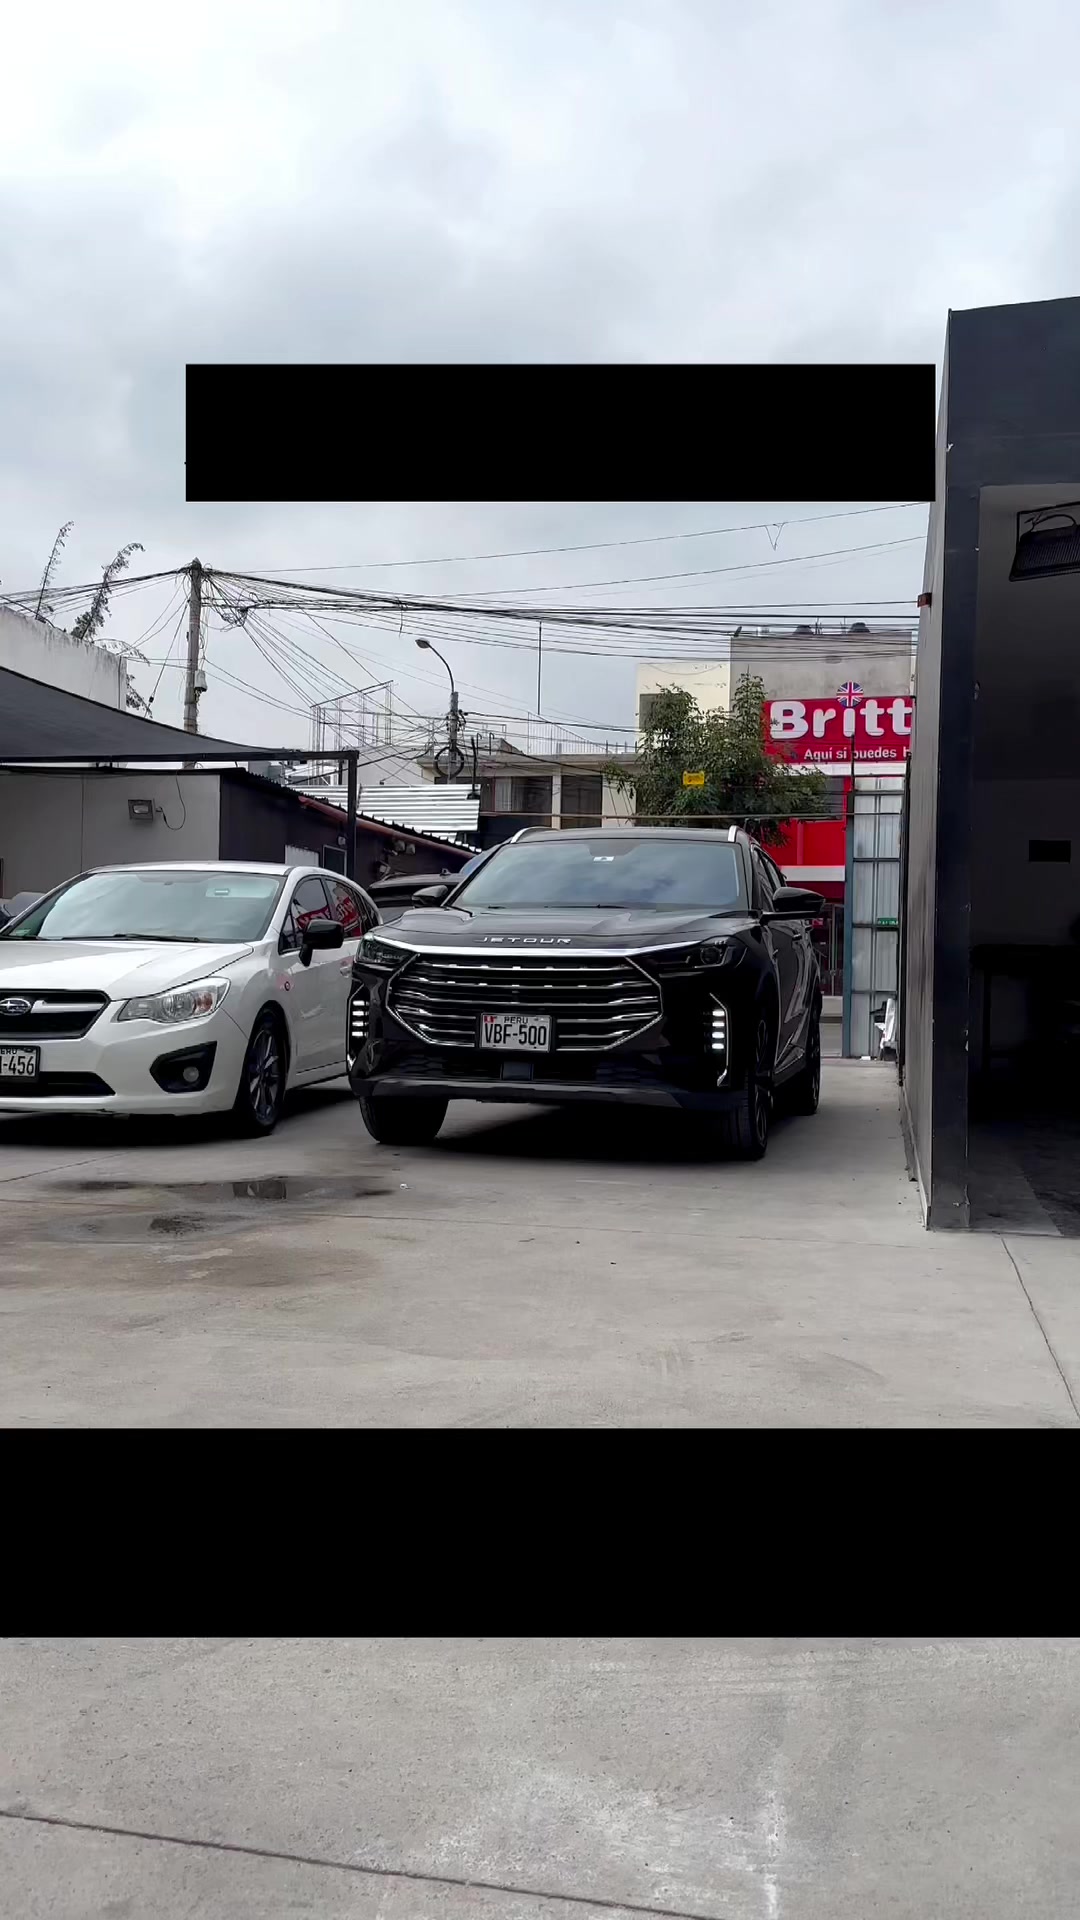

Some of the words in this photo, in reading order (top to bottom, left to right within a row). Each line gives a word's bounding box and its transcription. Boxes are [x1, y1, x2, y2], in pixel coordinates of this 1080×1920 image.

[483, 936, 572, 944] JETOUR
[503, 1016, 529, 1024] PERU
[484, 1022, 548, 1046] VBF-500
[0, 1055, 34, 1075] -456
